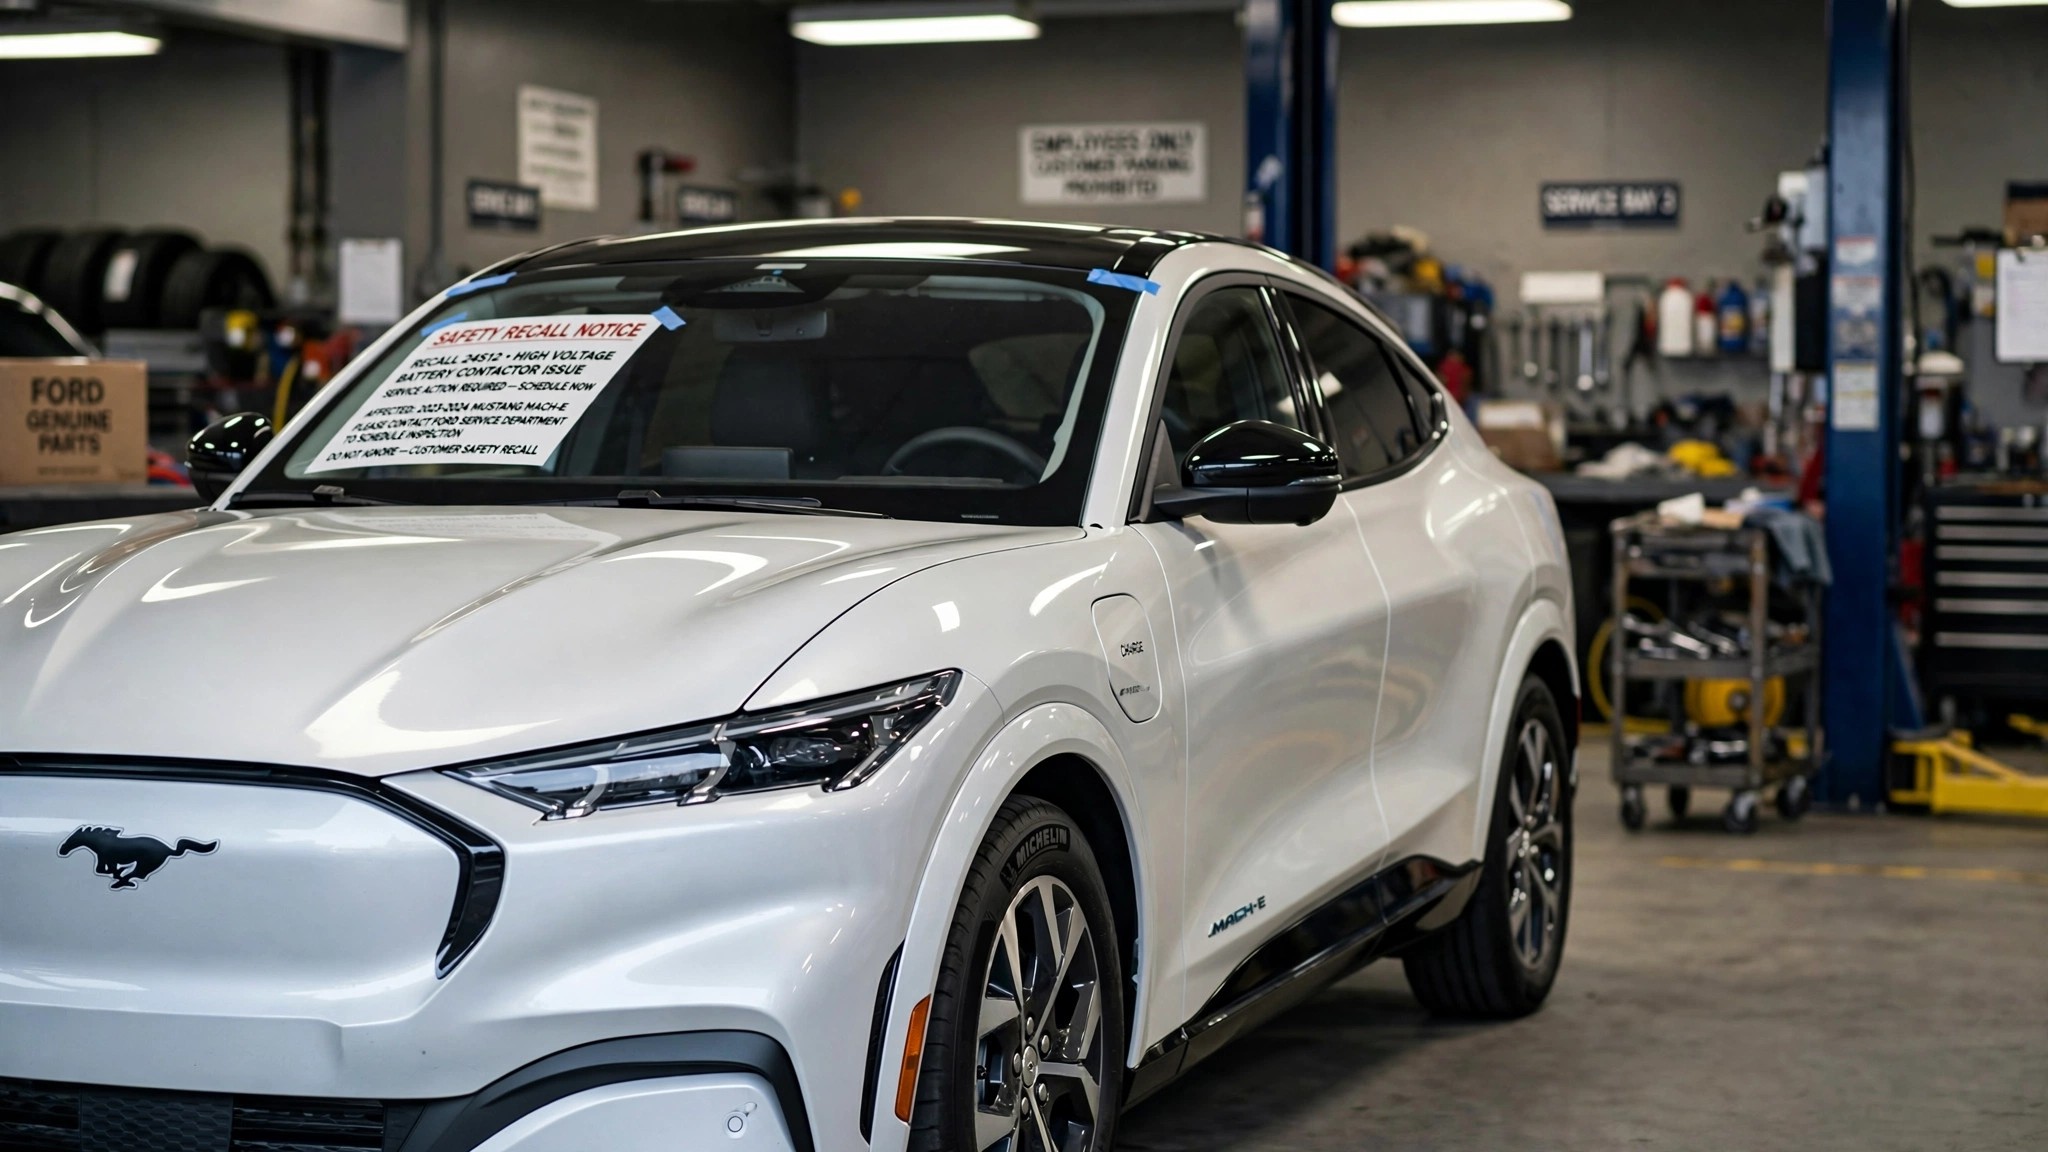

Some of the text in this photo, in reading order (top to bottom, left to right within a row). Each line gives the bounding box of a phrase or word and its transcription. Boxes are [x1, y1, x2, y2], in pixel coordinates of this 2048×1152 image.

[433, 322, 648, 345] SAFETY RECALL NOTICE
[410, 355, 458, 368] RECALL
[513, 351, 550, 361] HIGH
[552, 350, 616, 361] VOLTAGE
[396, 364, 586, 383] BATTERY CONTACTOR ISSUE
[30, 376, 105, 406] FORD
[382, 385, 423, 398] SERVICE
[422, 383, 459, 394] ACTION
[458, 382, 507, 393] REQUIRED
[517, 381, 571, 391] SCHEDULE
[568, 382, 597, 391] NOW
[470, 401, 524, 412] MUSTANG
[524, 402, 569, 412] MACH-E
[25, 409, 112, 433] GENUINE
[351, 416, 568, 432] PLEASE CONTACT FORD SERVICE DEPARTMENT
[405, 428, 463, 440] INSPECTION
[38, 434, 101, 455] PARTS
[326, 452, 342, 461] DO
[343, 449, 362, 459] NOT
[408, 445, 462, 455] CUSTOMER
[461, 444, 501, 455] SAFETY
[500, 445, 539, 455] RECALL
[1016, 827, 1068, 868] MICHELIN
[1208, 896, 1266, 938] MACH-E
